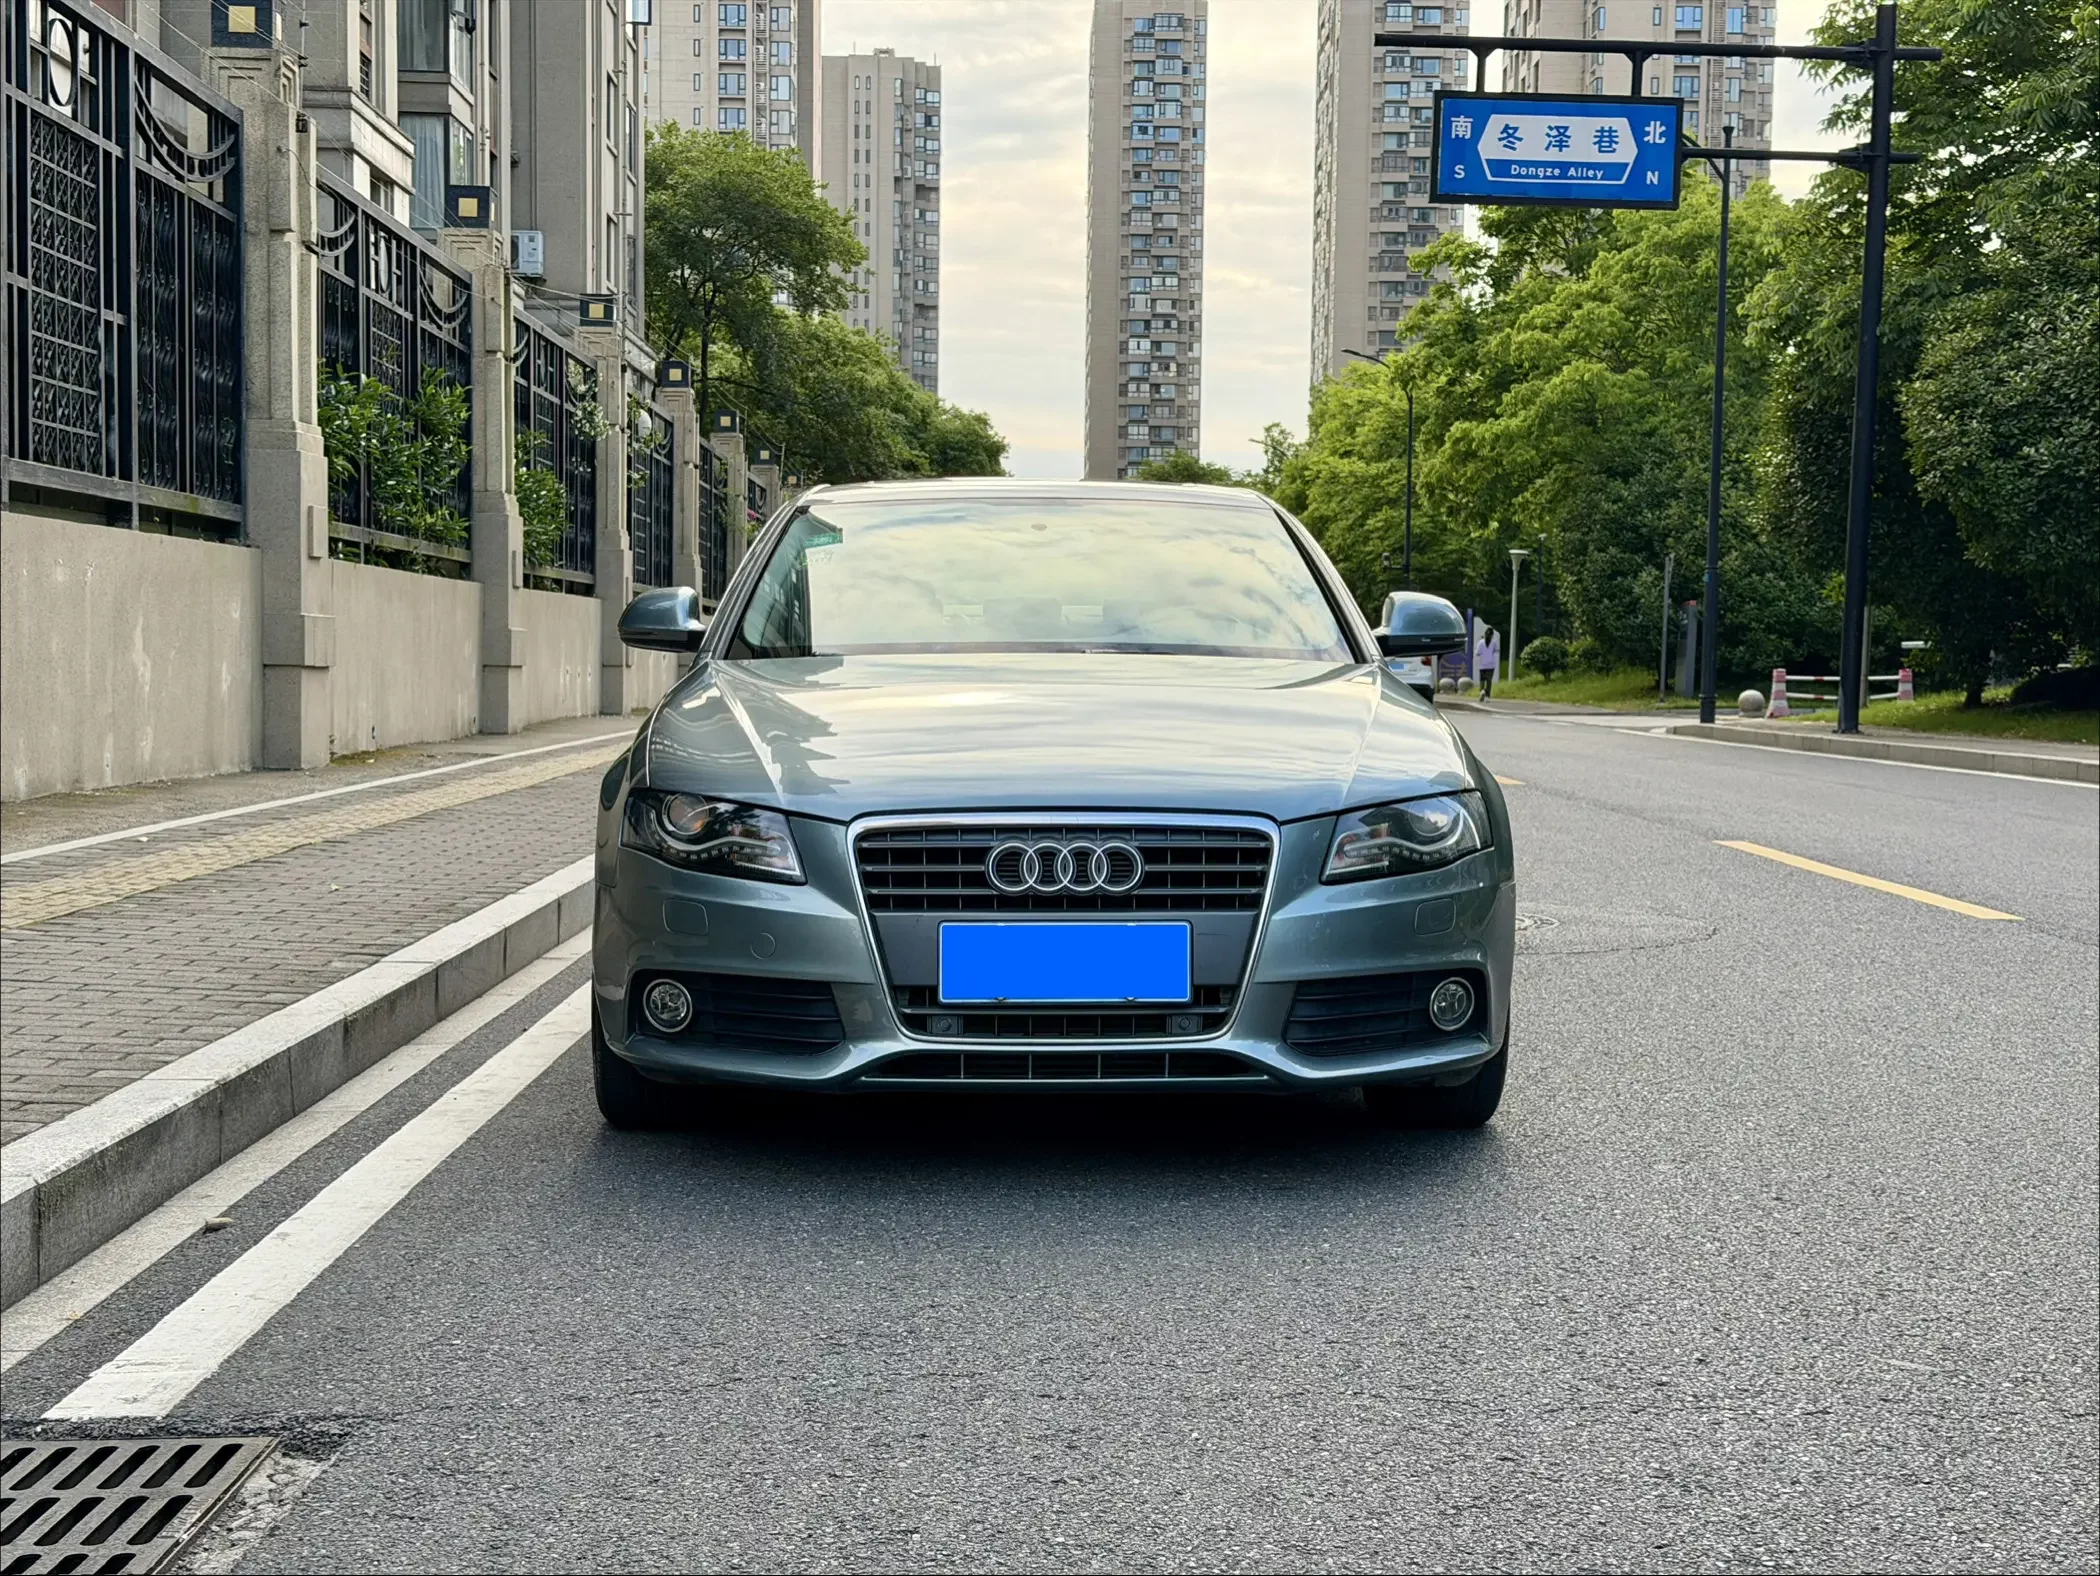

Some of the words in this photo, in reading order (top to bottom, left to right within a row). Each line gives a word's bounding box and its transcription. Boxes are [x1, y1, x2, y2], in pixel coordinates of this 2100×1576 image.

[1451, 116, 1473, 140] 南
[1644, 120, 1666, 144] 北
[1497, 123, 1620, 154] 冬泽巷
[1454, 165, 1465, 179] S
[1511, 165, 1561, 179] Dongze
[1567, 167, 1604, 180] Alley
[1646, 171, 1659, 185] N
